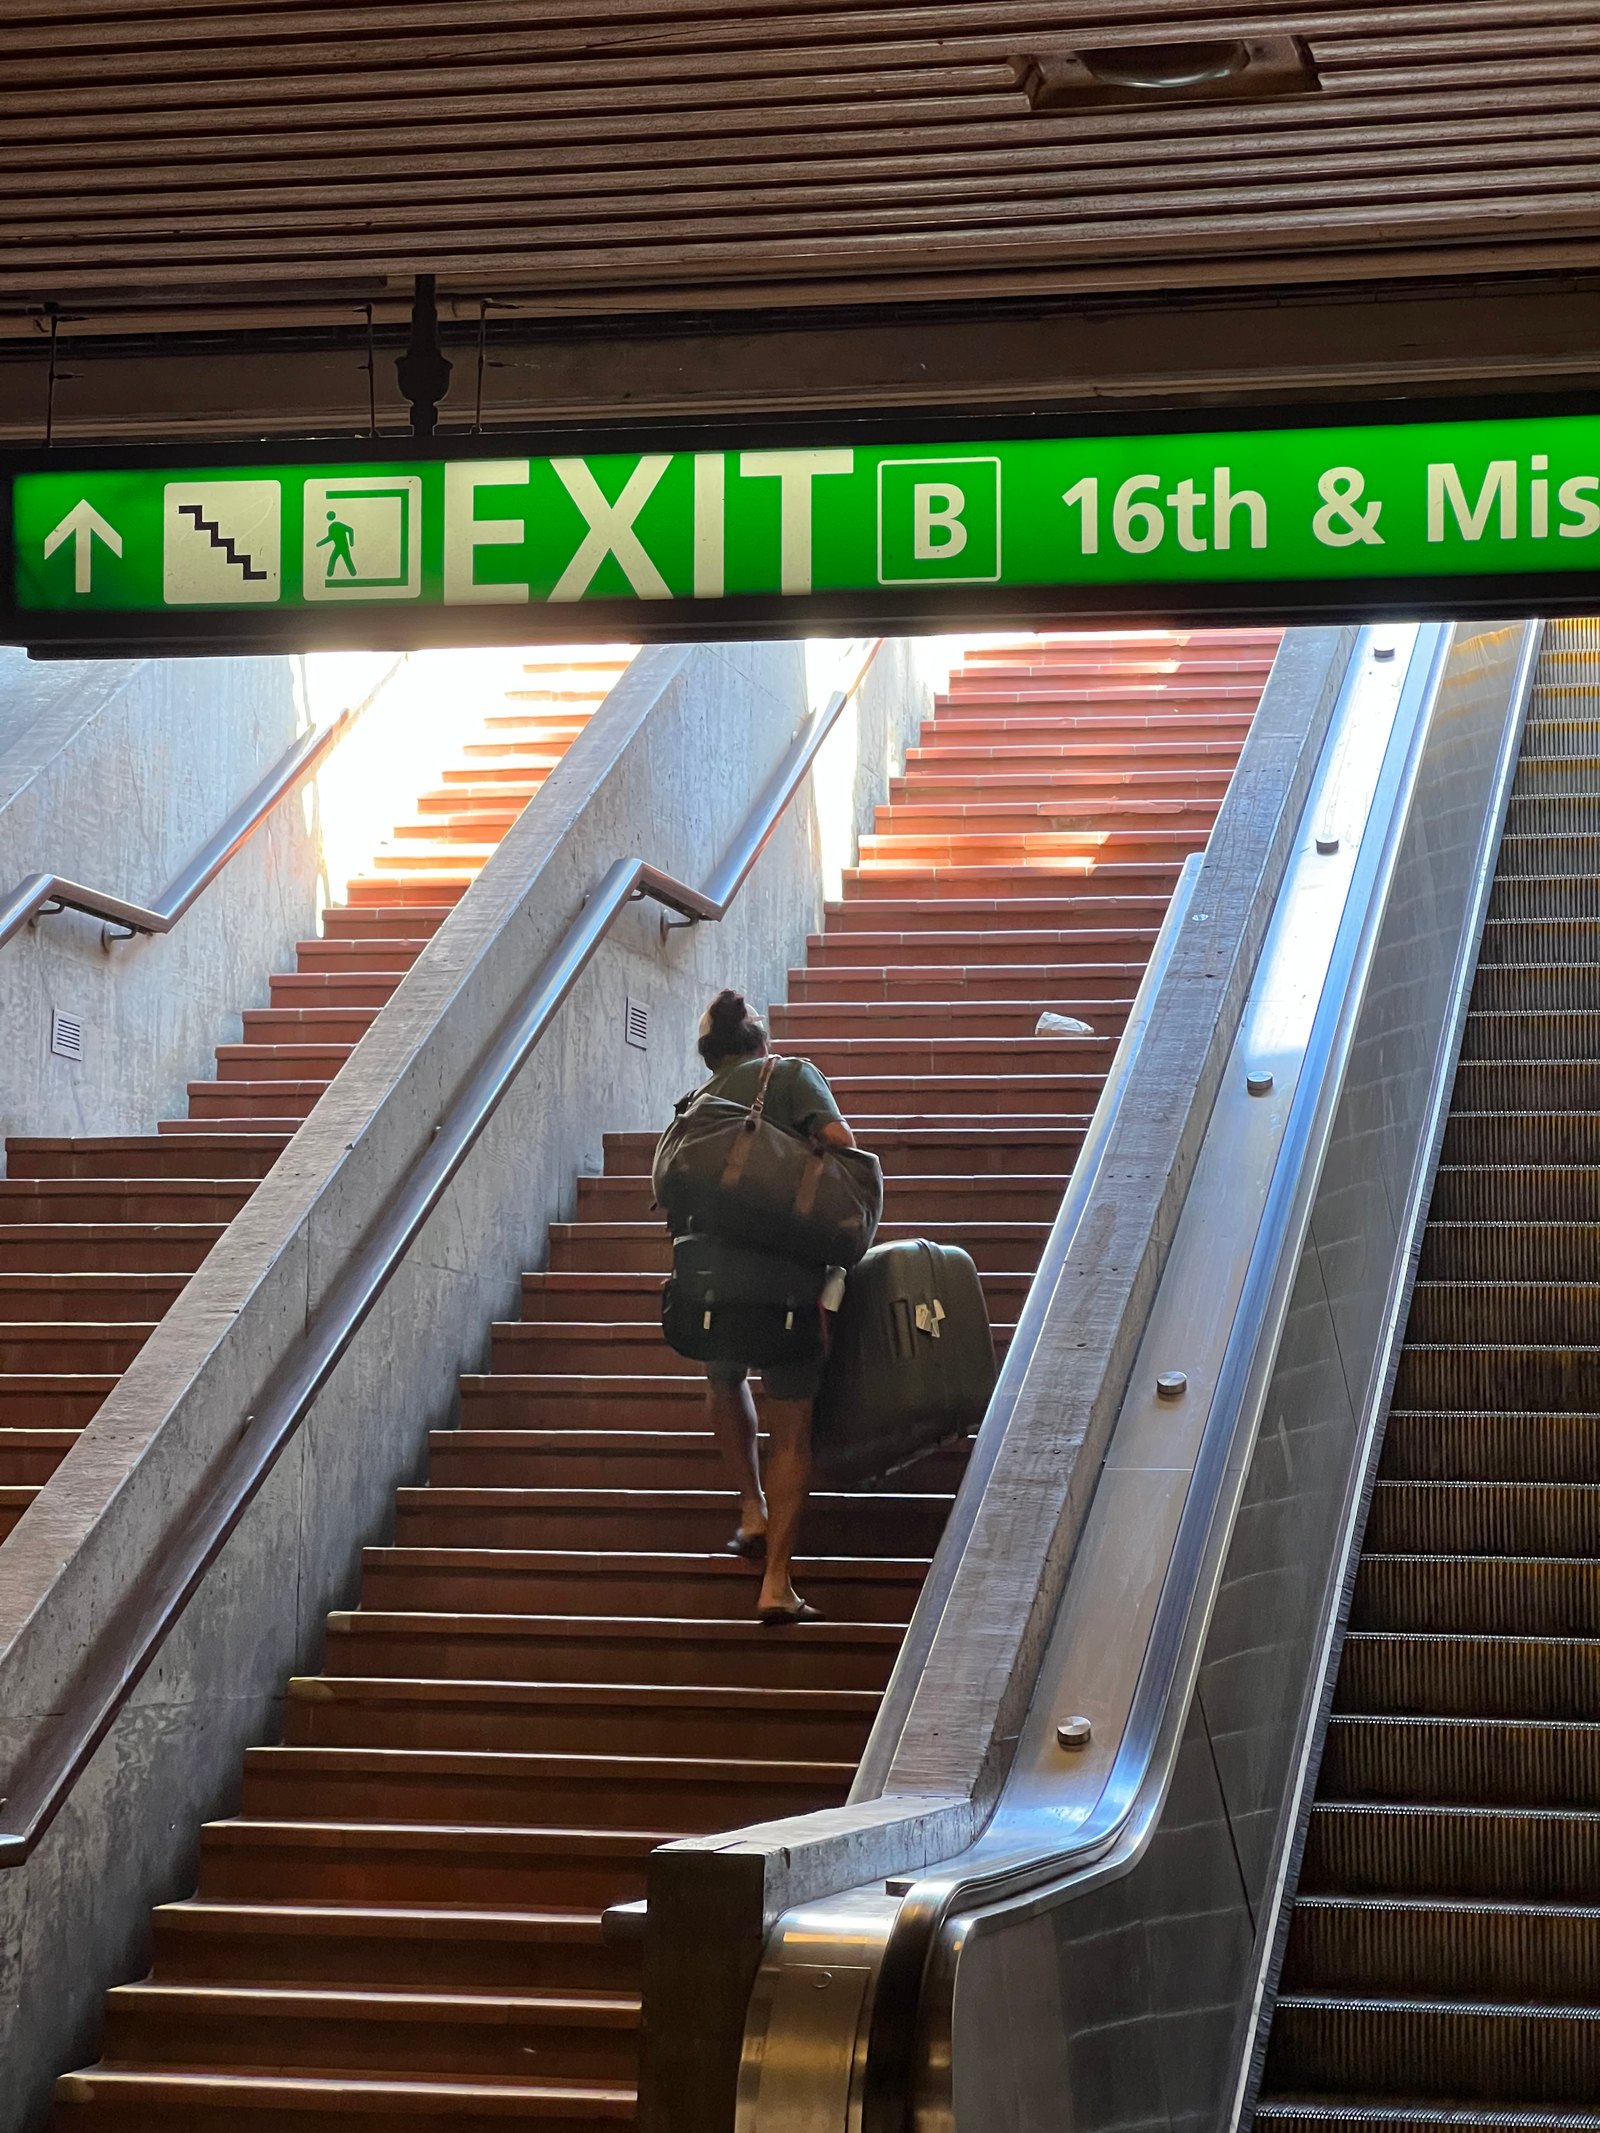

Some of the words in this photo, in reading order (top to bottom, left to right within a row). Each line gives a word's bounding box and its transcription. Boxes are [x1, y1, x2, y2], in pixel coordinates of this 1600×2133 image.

[443, 448, 854, 604] EXIT
[913, 482, 969, 561] B
[1061, 466, 1268, 554] 16th
[1312, 466, 1386, 548] &
[1427, 454, 1600, 542] Mis
